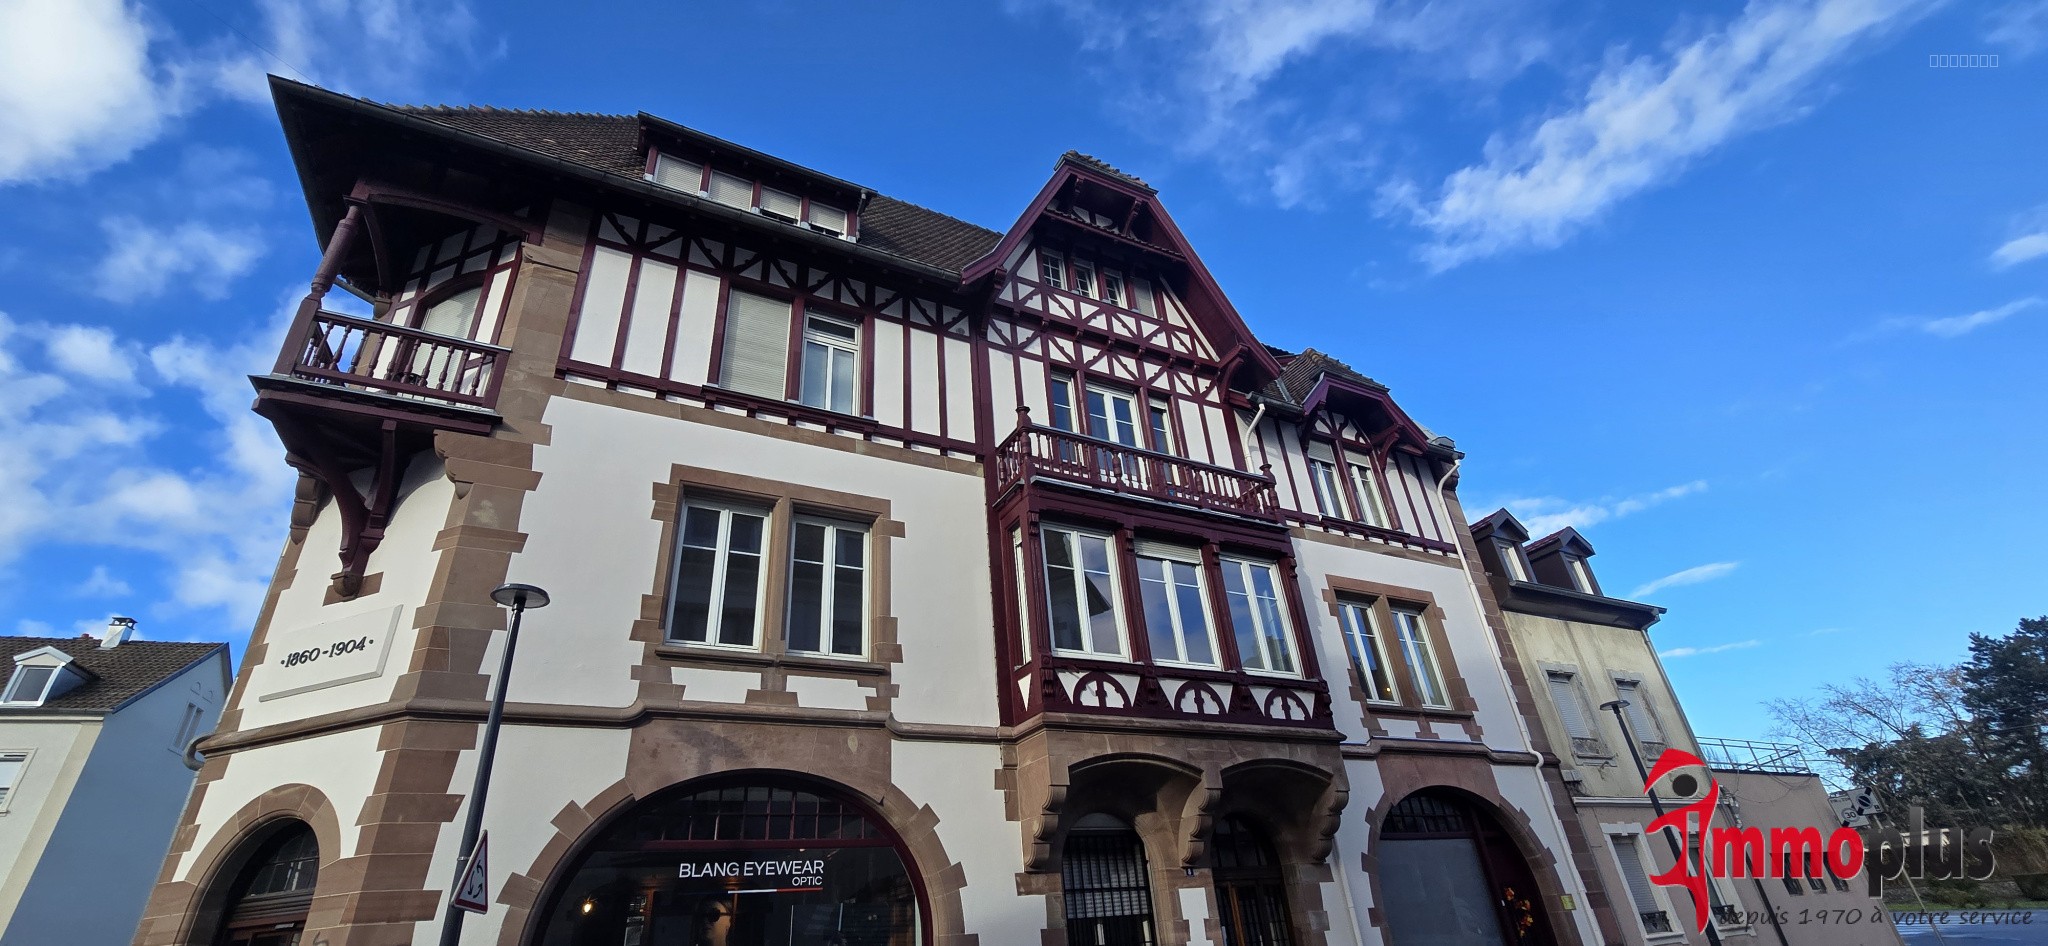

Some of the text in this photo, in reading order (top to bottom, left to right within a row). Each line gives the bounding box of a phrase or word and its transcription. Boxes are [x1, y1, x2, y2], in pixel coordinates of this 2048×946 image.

[678, 860, 825, 878] BLANG EYEWEAR
[791, 876, 823, 887] OPTIC
